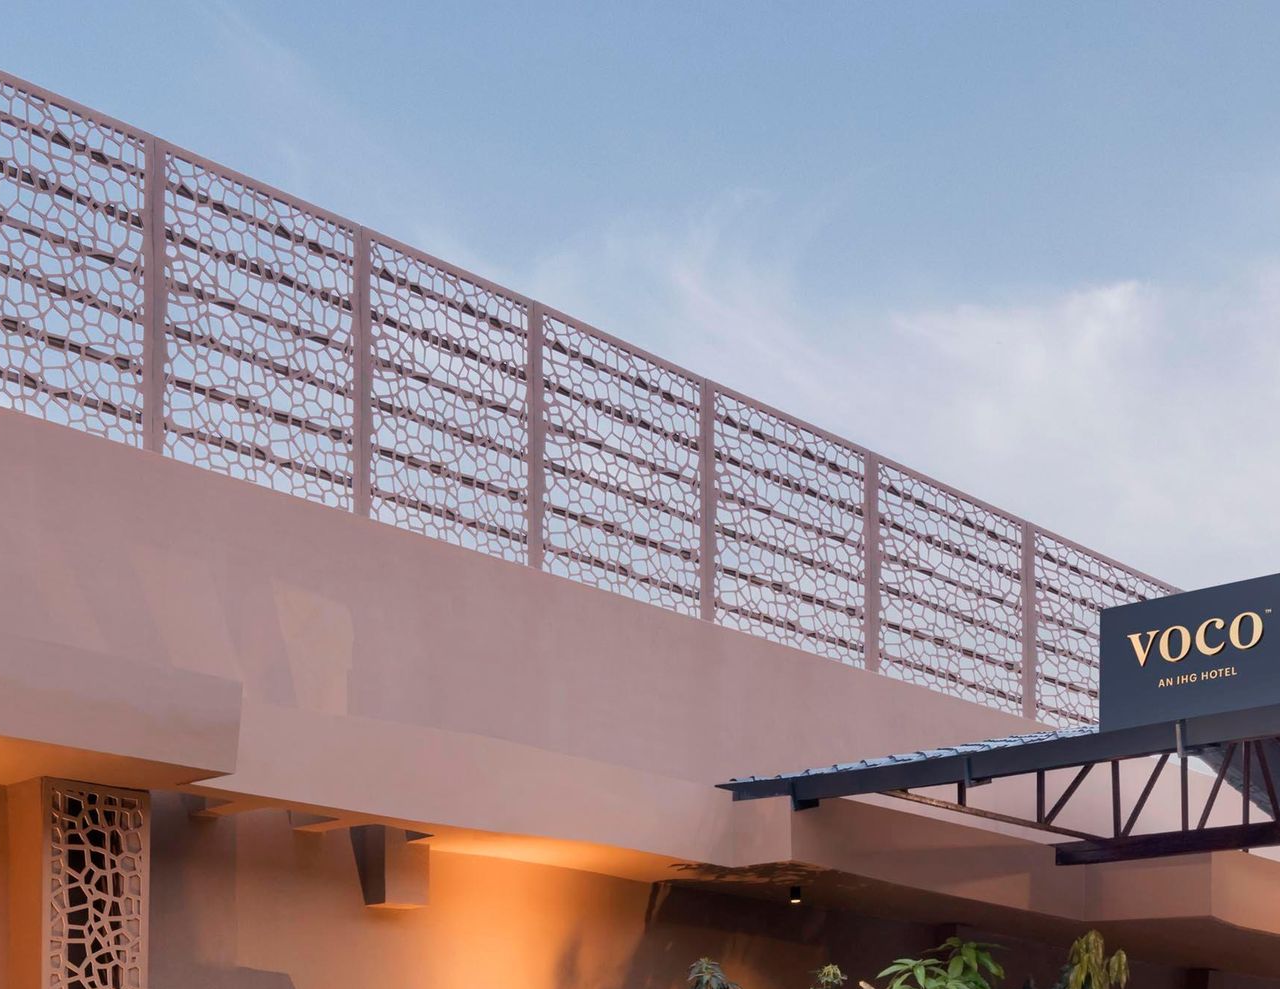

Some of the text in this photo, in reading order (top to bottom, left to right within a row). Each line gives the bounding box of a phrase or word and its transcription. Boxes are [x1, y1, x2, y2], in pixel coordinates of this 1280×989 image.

[1158, 666, 1238, 688] AN IHG HOTEL
